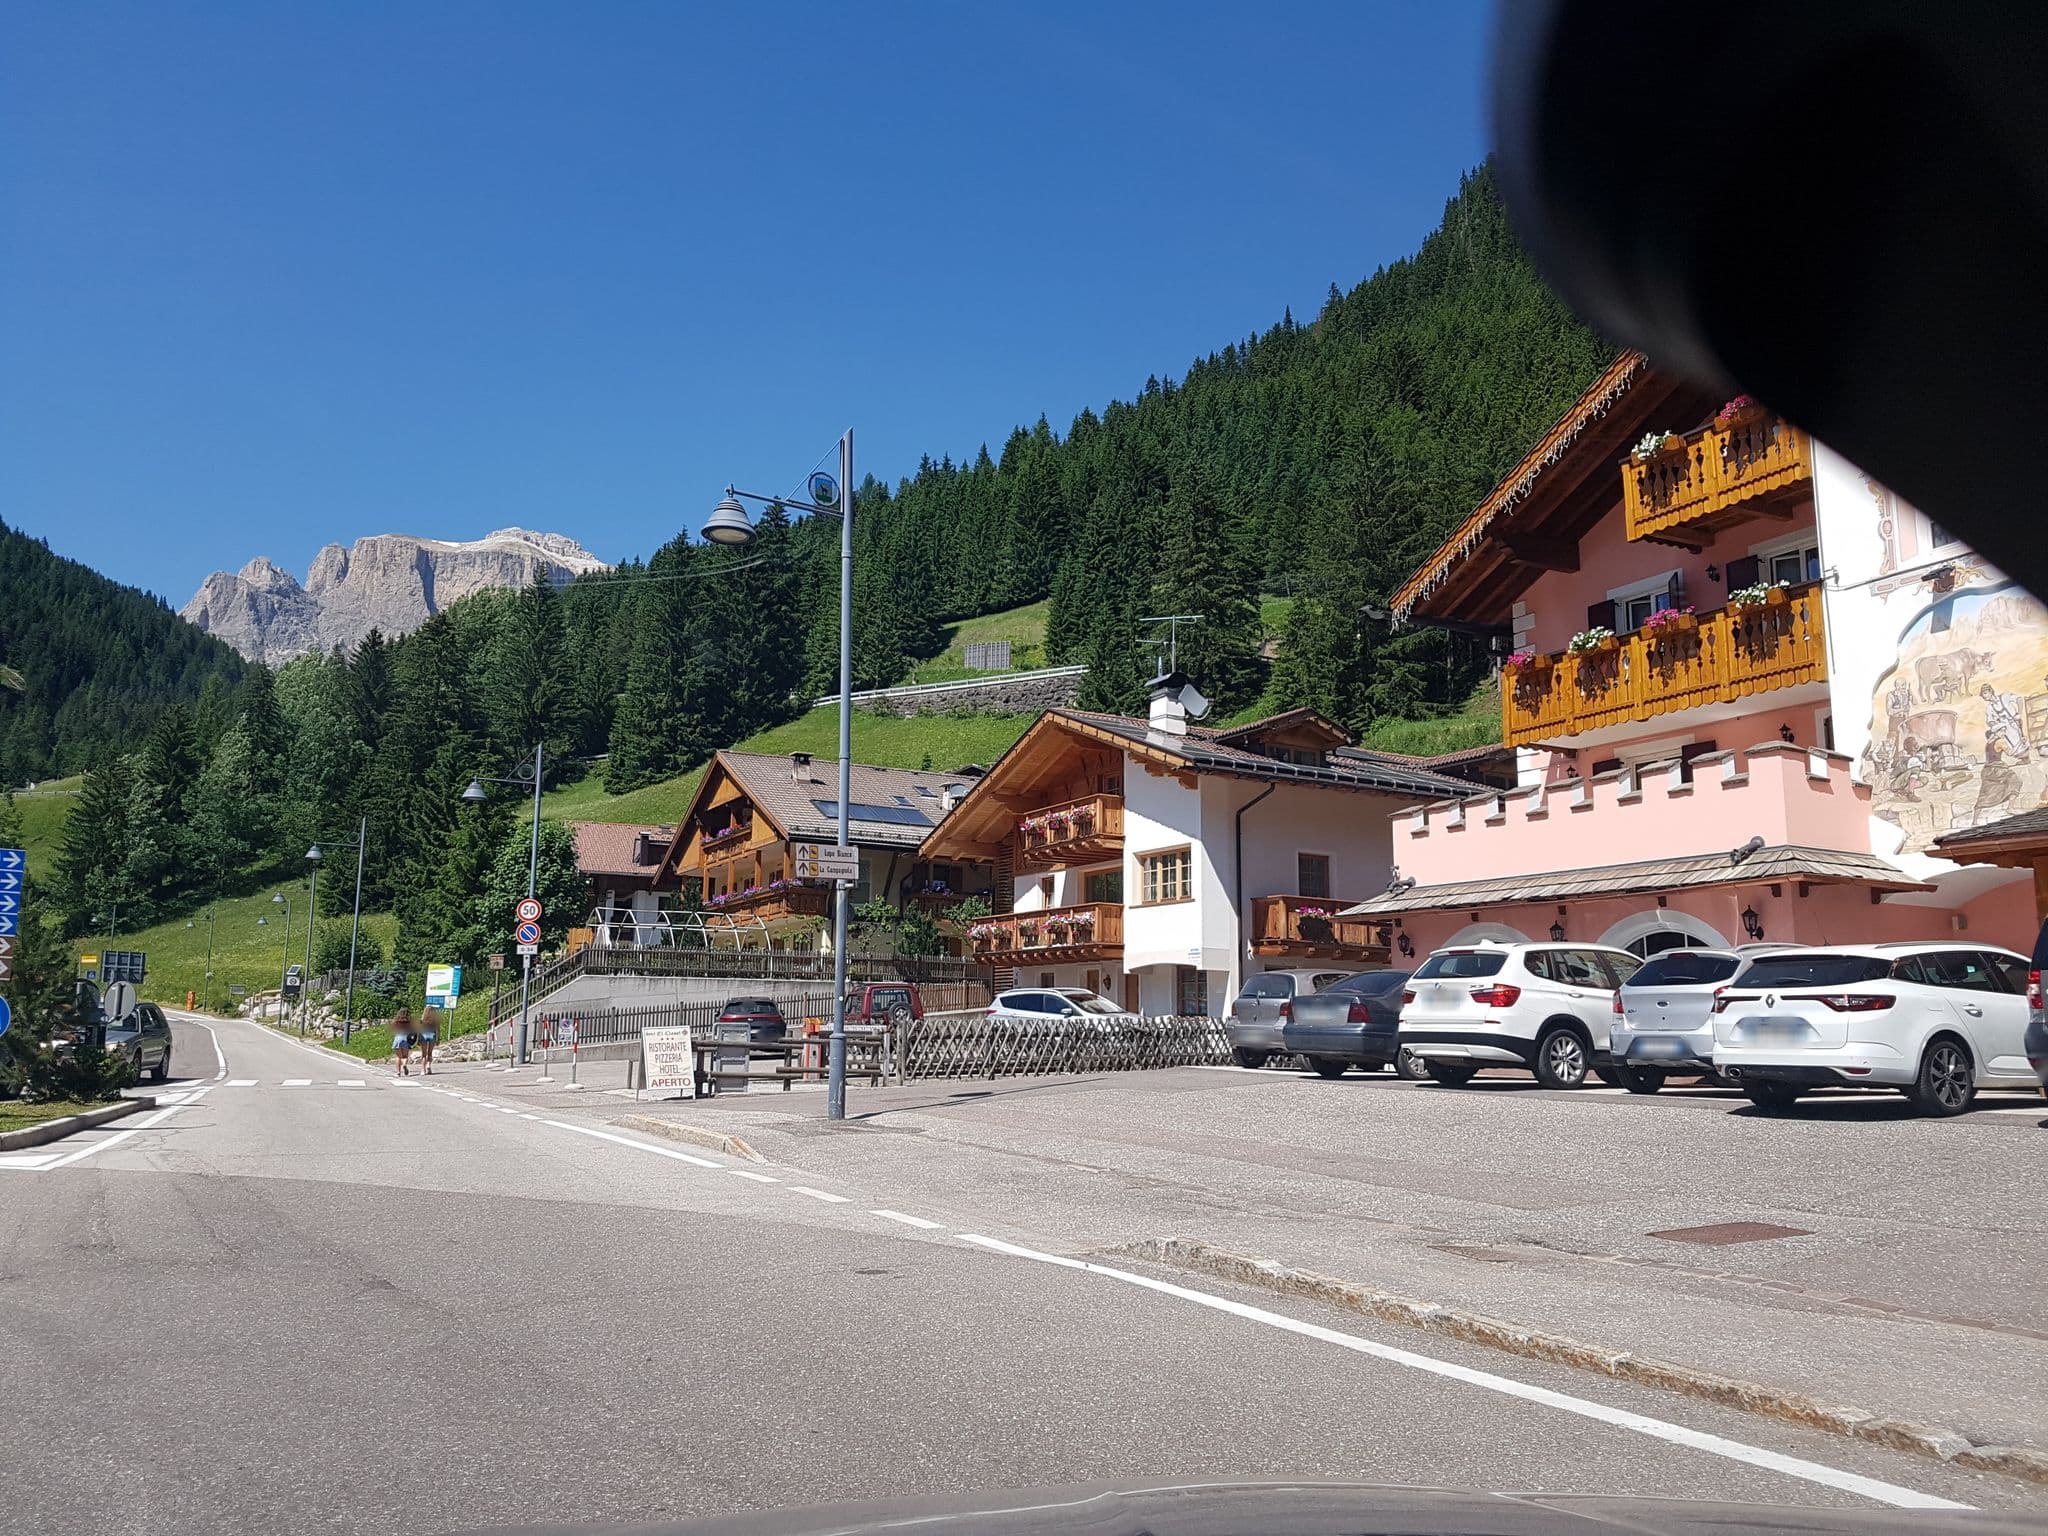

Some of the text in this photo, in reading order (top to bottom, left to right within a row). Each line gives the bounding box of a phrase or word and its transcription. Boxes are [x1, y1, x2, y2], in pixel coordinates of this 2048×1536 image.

[523, 905, 536, 915] 50
[648, 1042, 687, 1052] RISTORANTE
[655, 1053, 683, 1063] PIZZERIA
[660, 1065, 680, 1074] HOTEL
[651, 1078, 691, 1087] APERTO
